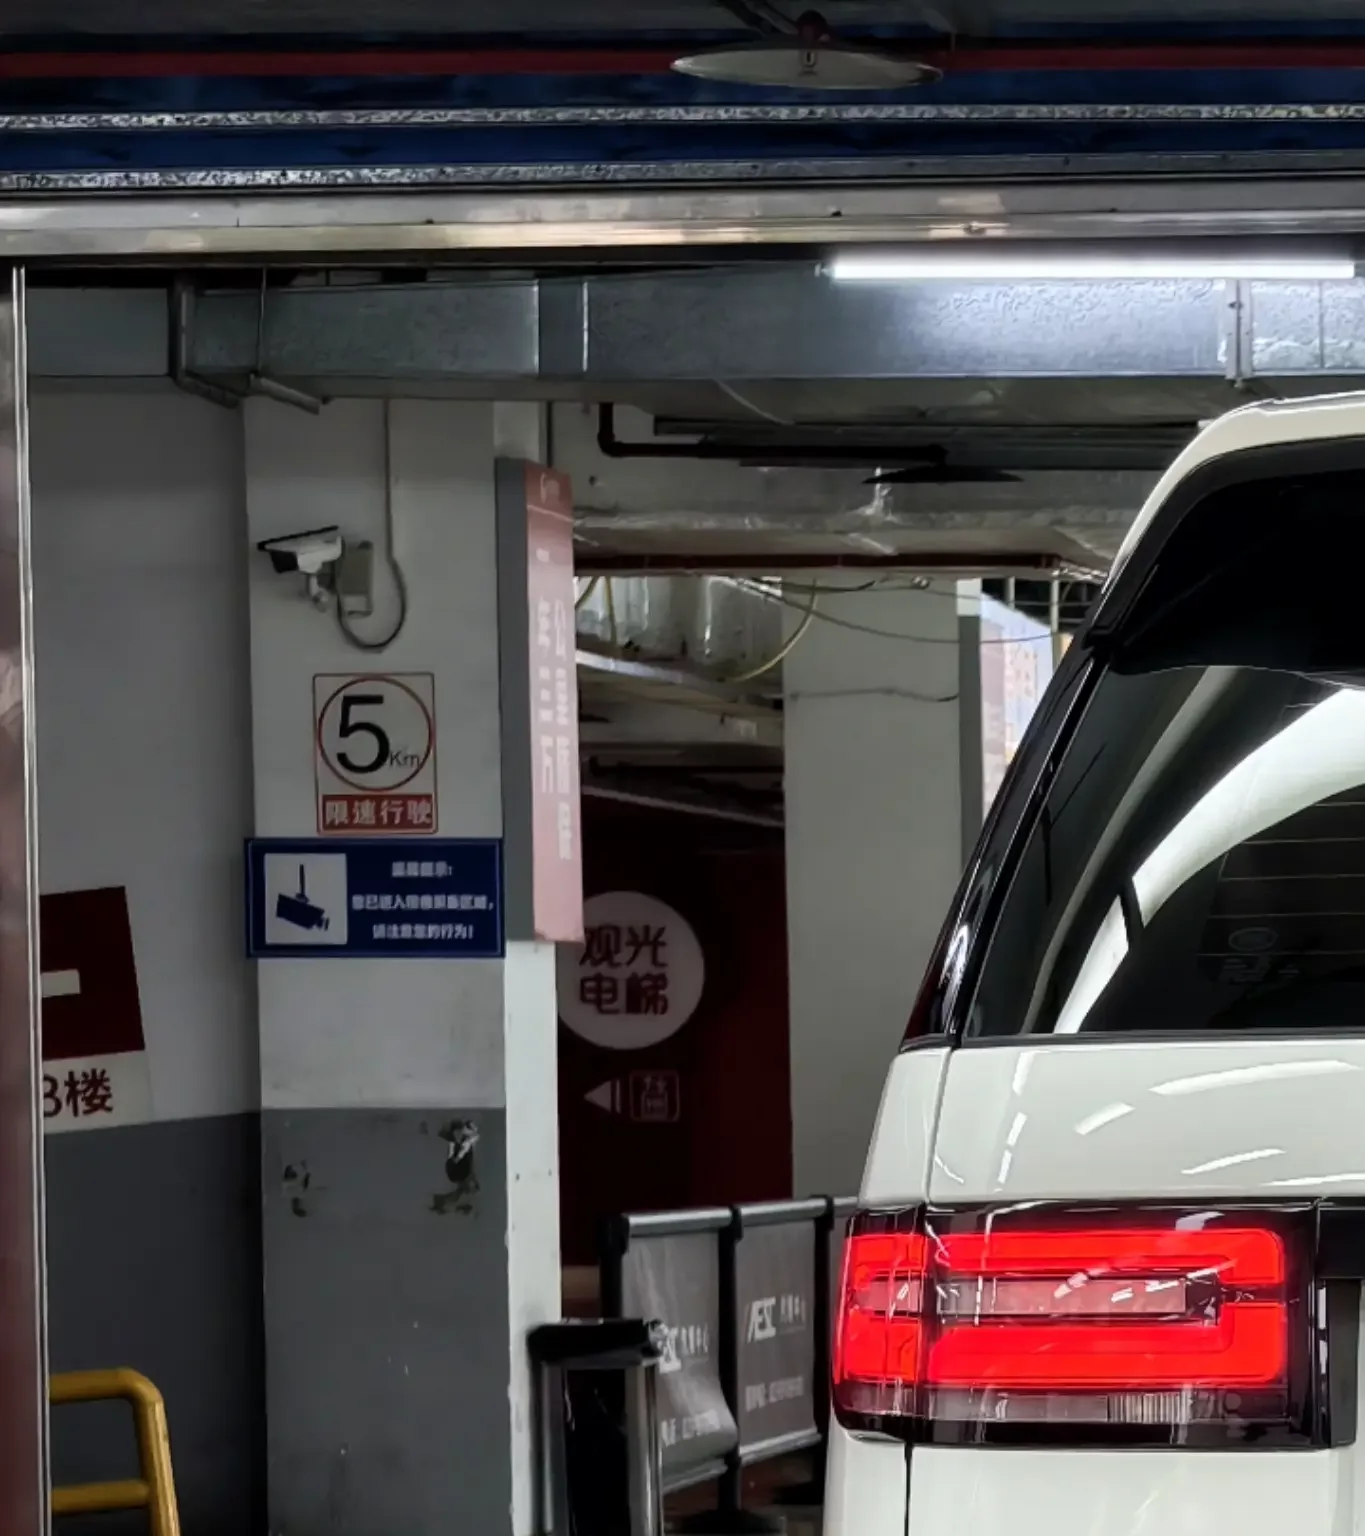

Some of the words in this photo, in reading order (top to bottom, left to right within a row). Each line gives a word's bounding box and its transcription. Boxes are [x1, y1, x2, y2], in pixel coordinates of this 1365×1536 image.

[325, 799, 433, 826] 限速行驶
[579, 924, 669, 968] 观光
[579, 972, 669, 1016] 电梯
